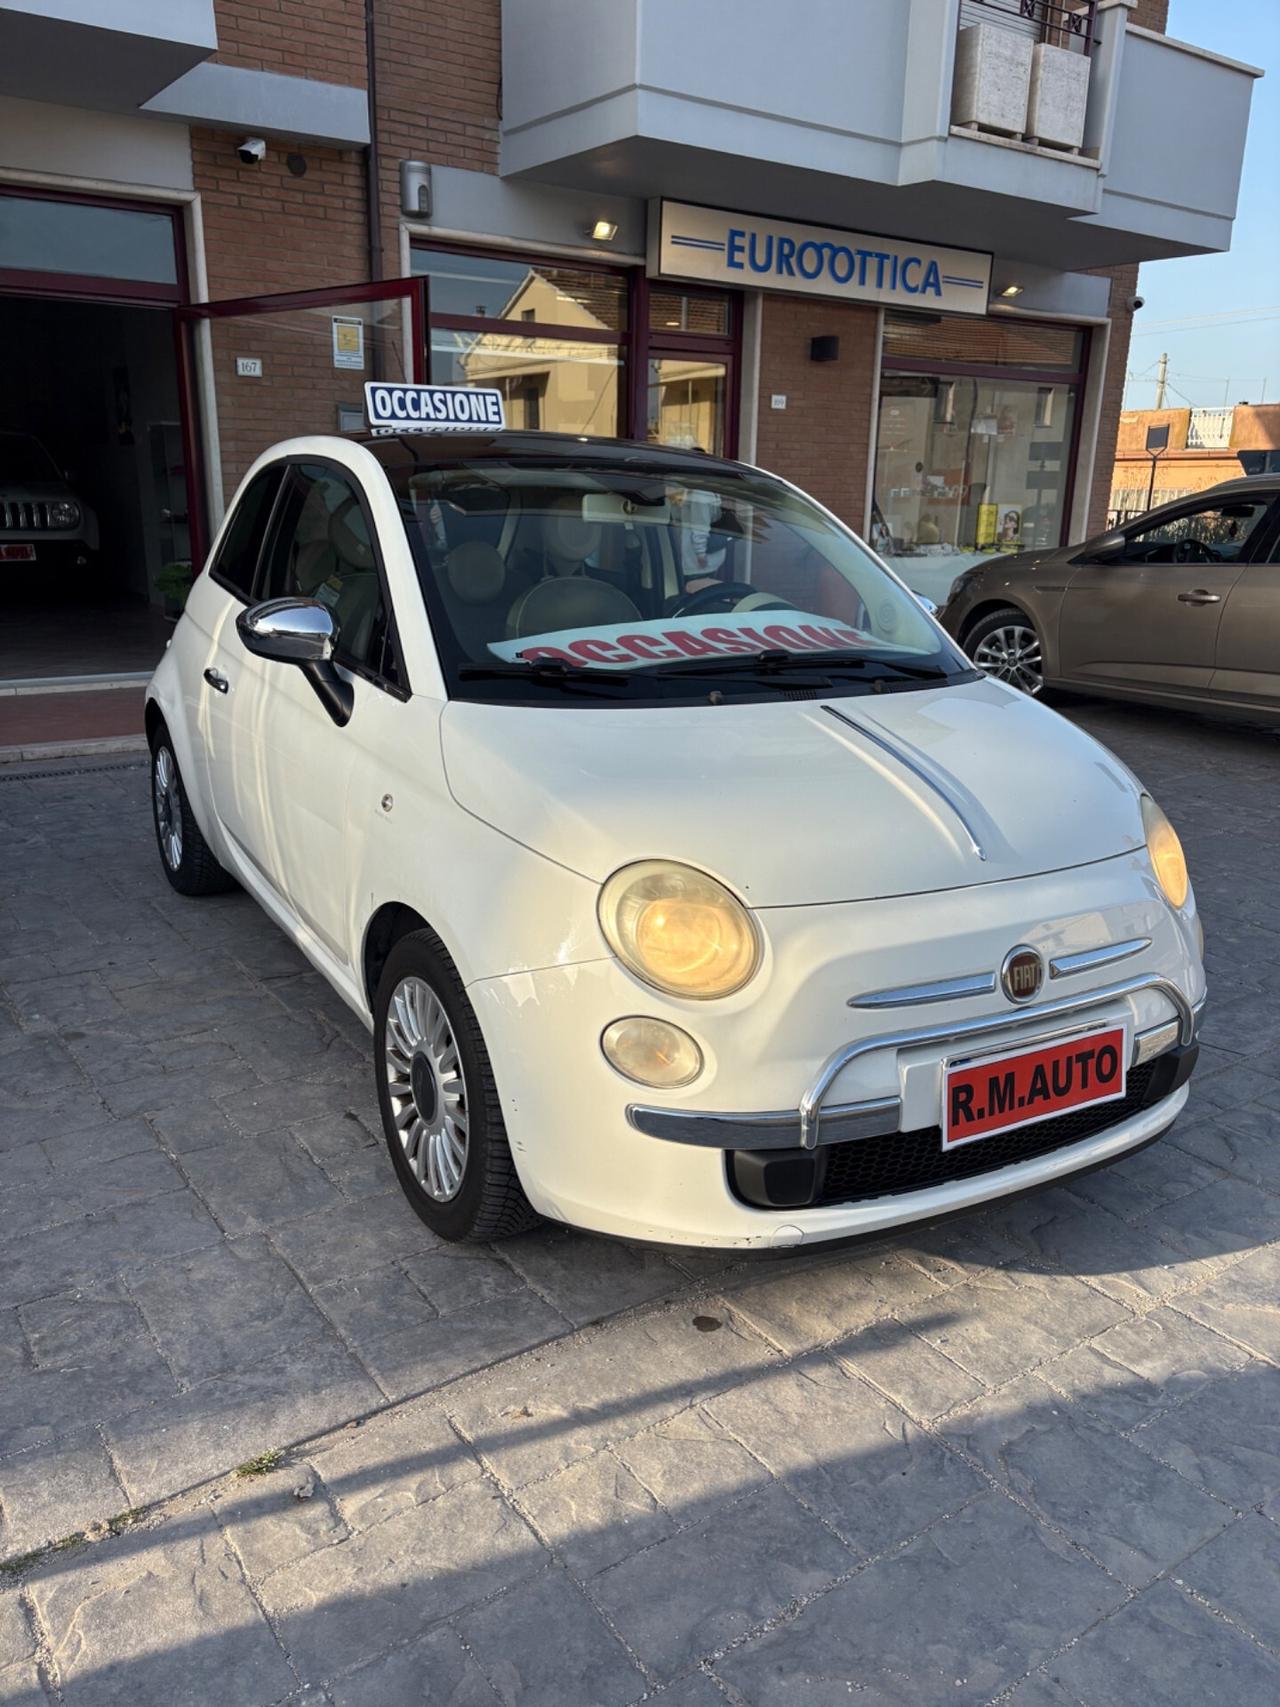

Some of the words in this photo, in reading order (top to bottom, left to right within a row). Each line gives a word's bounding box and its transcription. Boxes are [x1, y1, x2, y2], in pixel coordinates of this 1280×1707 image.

[727, 228, 942, 297] EUROOTTICA
[241, 361, 257, 373] 167
[374, 389, 500, 422] OCCASIONE
[1013, 963, 1037, 991] FIAT
[951, 1044, 1118, 1127] R.M.AUTO
